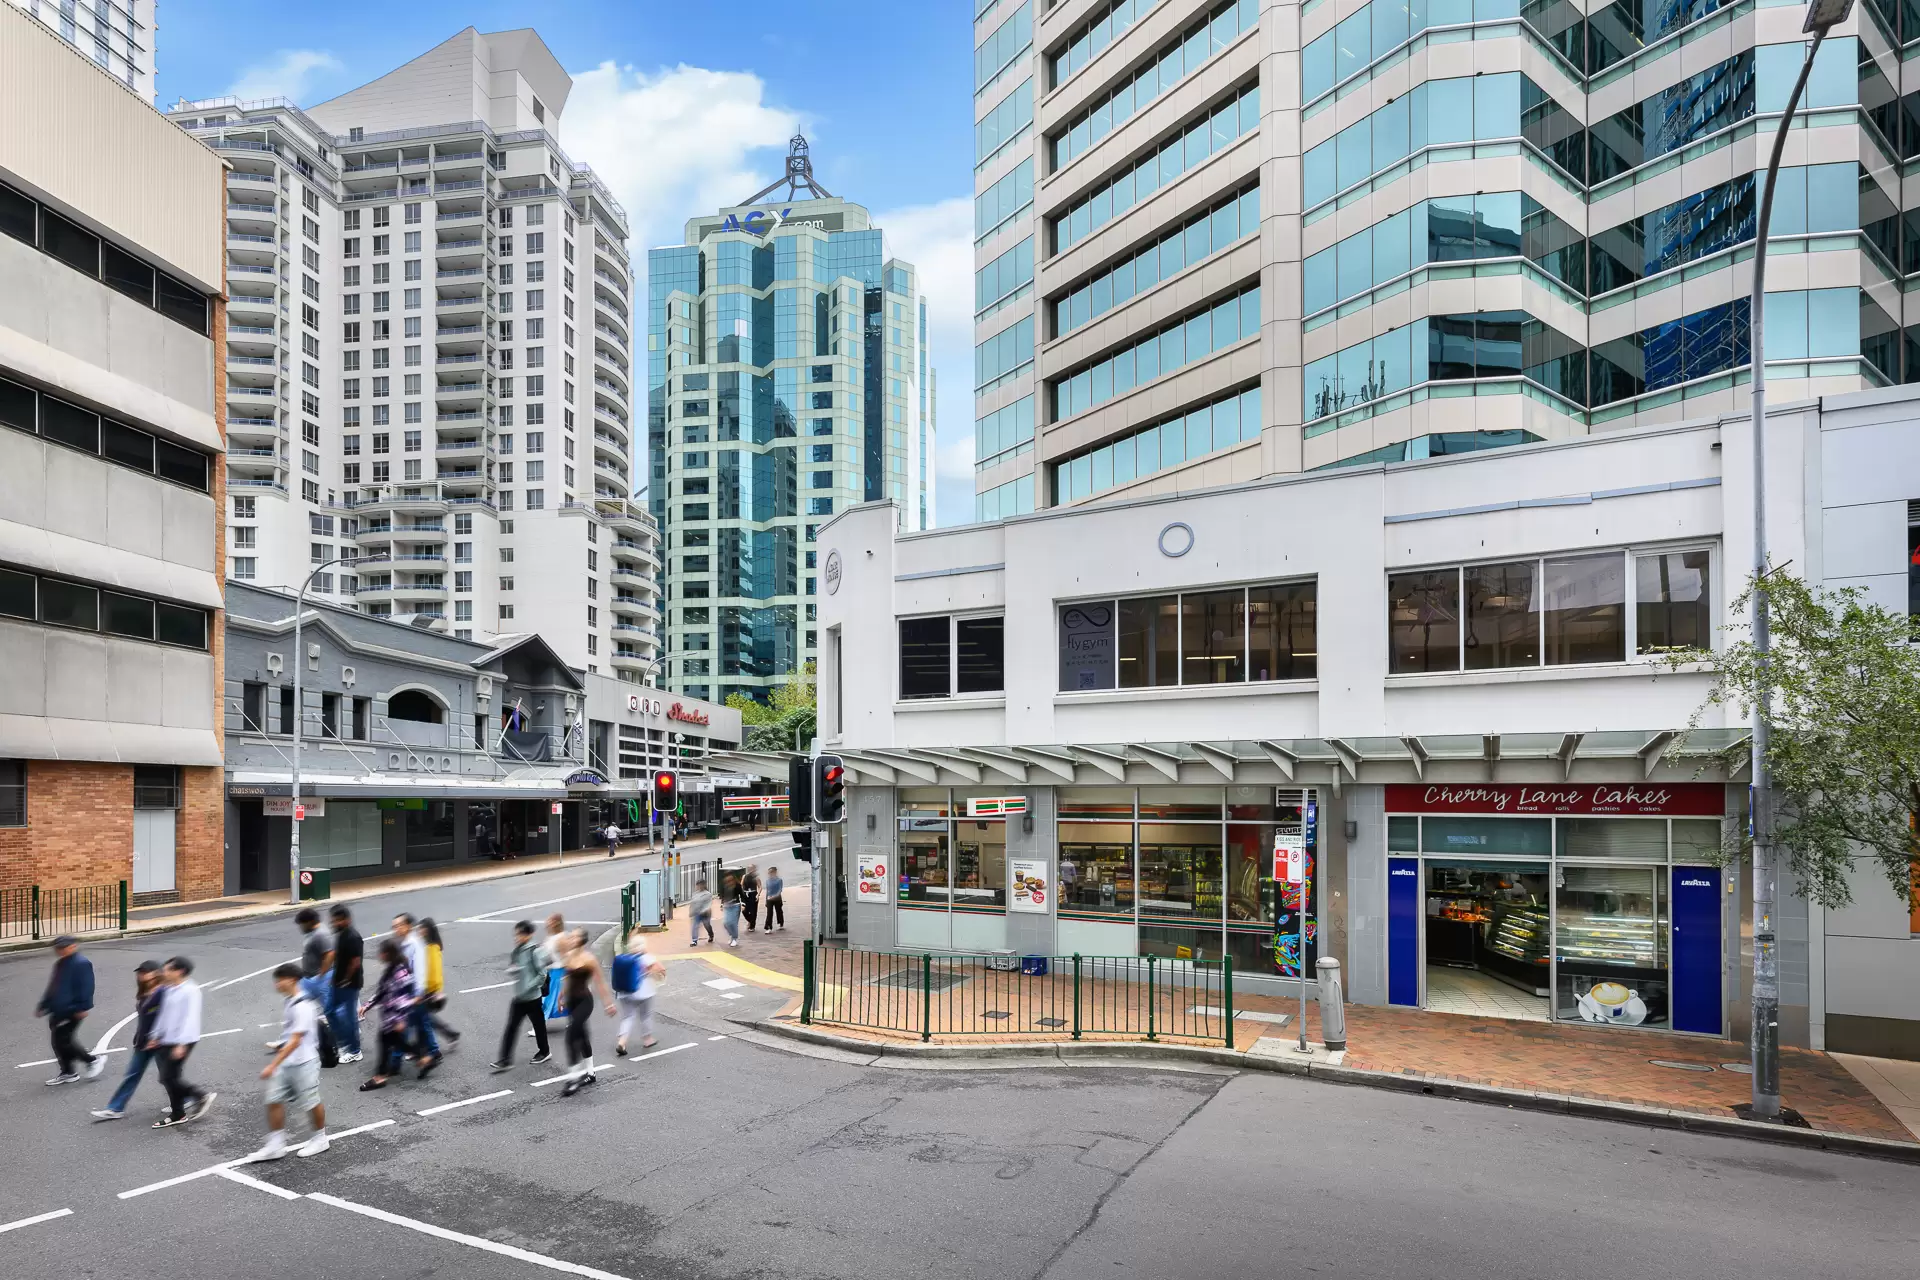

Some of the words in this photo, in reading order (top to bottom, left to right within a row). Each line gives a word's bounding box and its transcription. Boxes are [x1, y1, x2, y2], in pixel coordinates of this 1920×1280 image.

[229, 786, 267, 794] chatswoo
[1424, 786, 1511, 810] Cherry
[1519, 788, 1583, 804] Lane
[1592, 786, 1671, 804] Cakes
